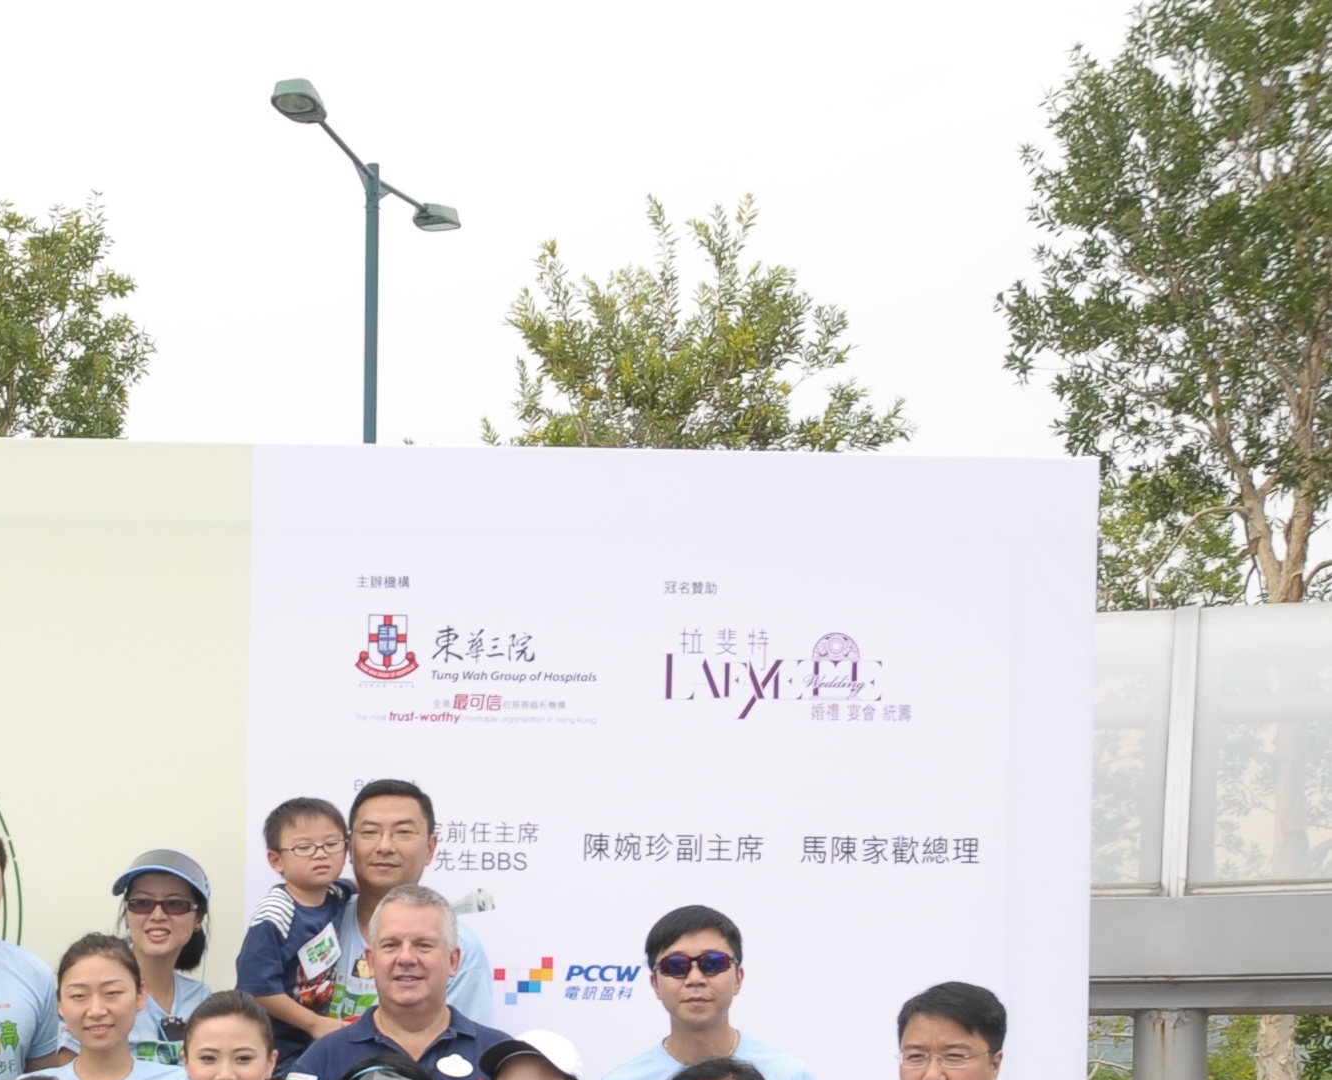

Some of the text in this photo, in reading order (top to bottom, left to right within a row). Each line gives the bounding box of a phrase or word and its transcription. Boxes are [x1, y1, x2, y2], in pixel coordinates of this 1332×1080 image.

[356, 575, 411, 589] 主辦機構
[663, 581, 718, 595] 冠名贊助
[431, 625, 536, 663] 東華三院
[430, 670, 598, 684] Tung Wah Group of Hospitals
[388, 710, 461, 724] trust-worthy
[583, 833, 765, 864] 陳婉珍副主席
[799, 835, 981, 864] 馬陳家歡總理
[565, 964, 642, 982] PCCW
[564, 985, 634, 1001] 電訊盈科
